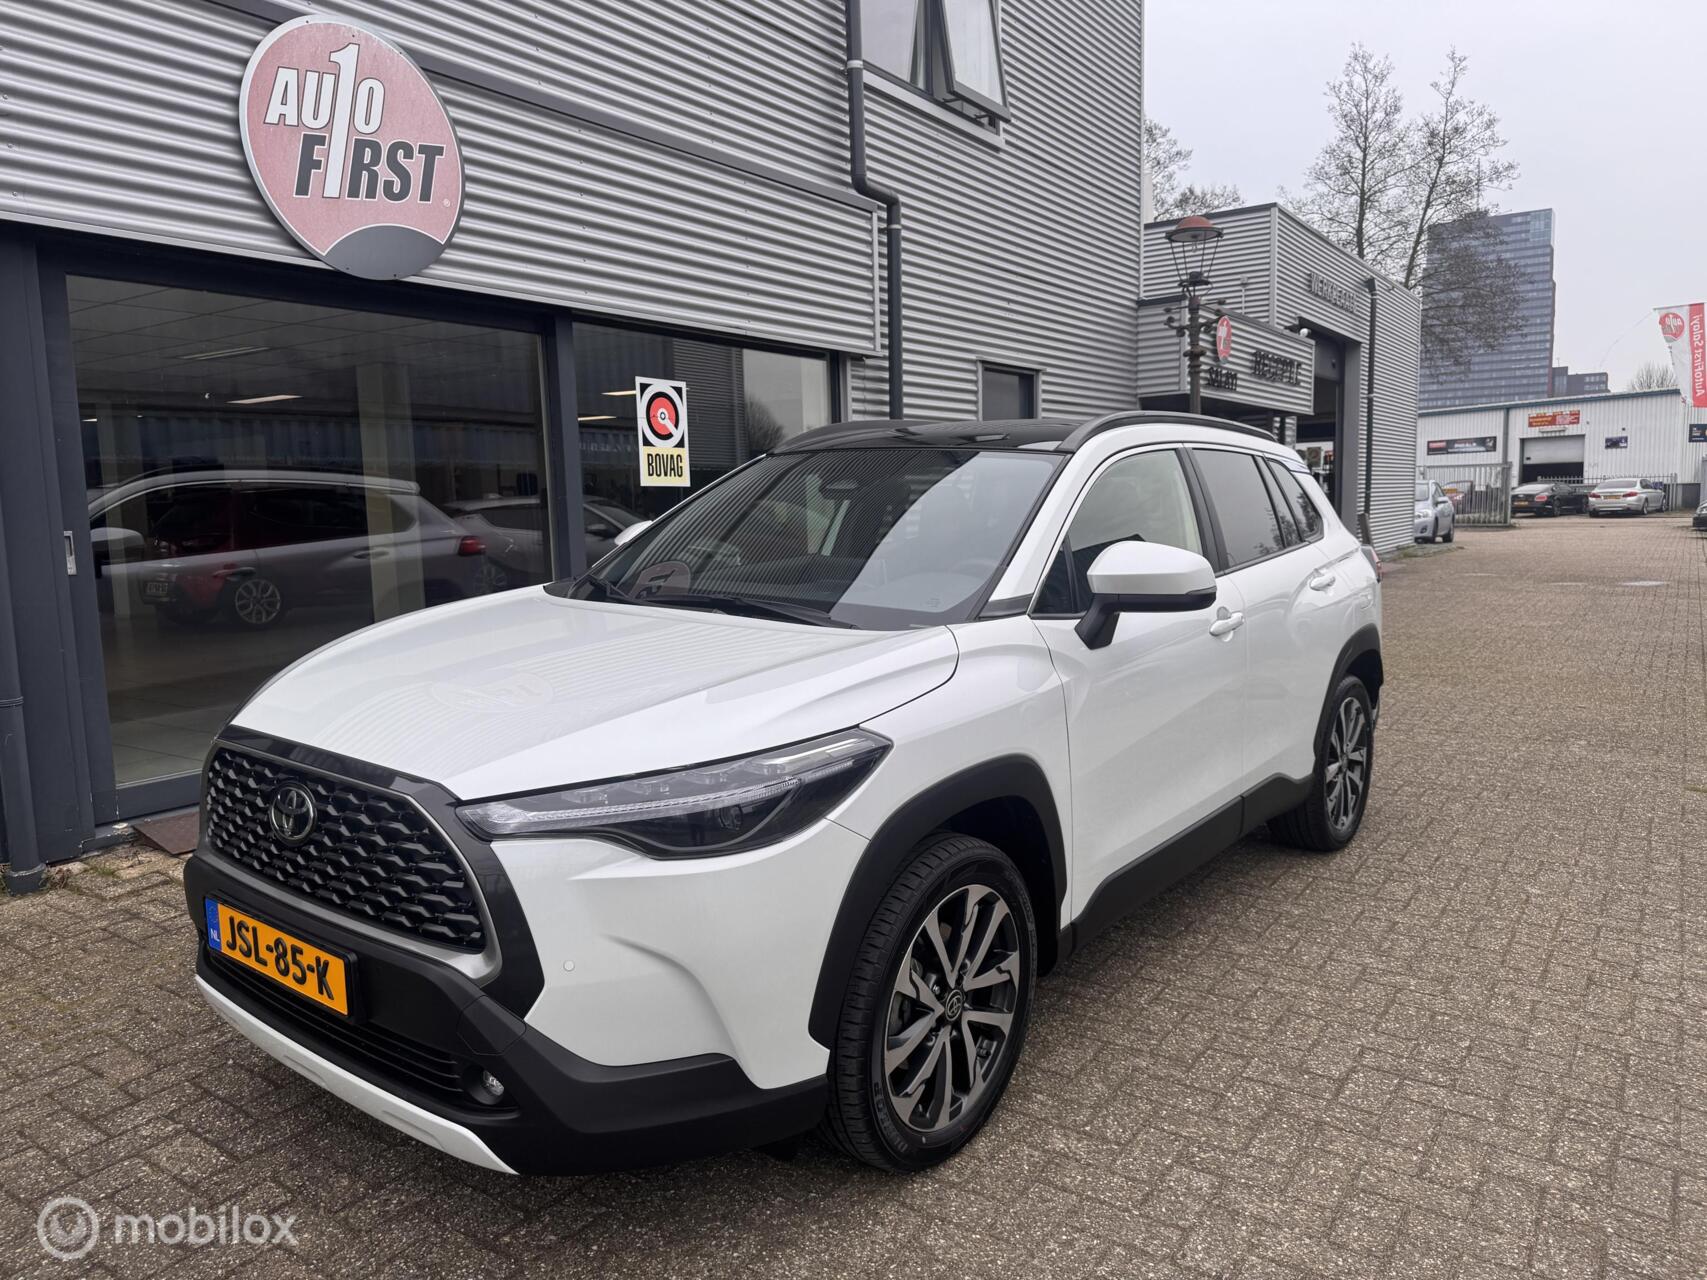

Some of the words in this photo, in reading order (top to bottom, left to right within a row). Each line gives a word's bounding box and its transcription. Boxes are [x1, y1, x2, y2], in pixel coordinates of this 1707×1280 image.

[646, 453, 683, 478] BOVAG
[210, 928, 220, 942] NL
[226, 915, 335, 1001] JSL-85-K
